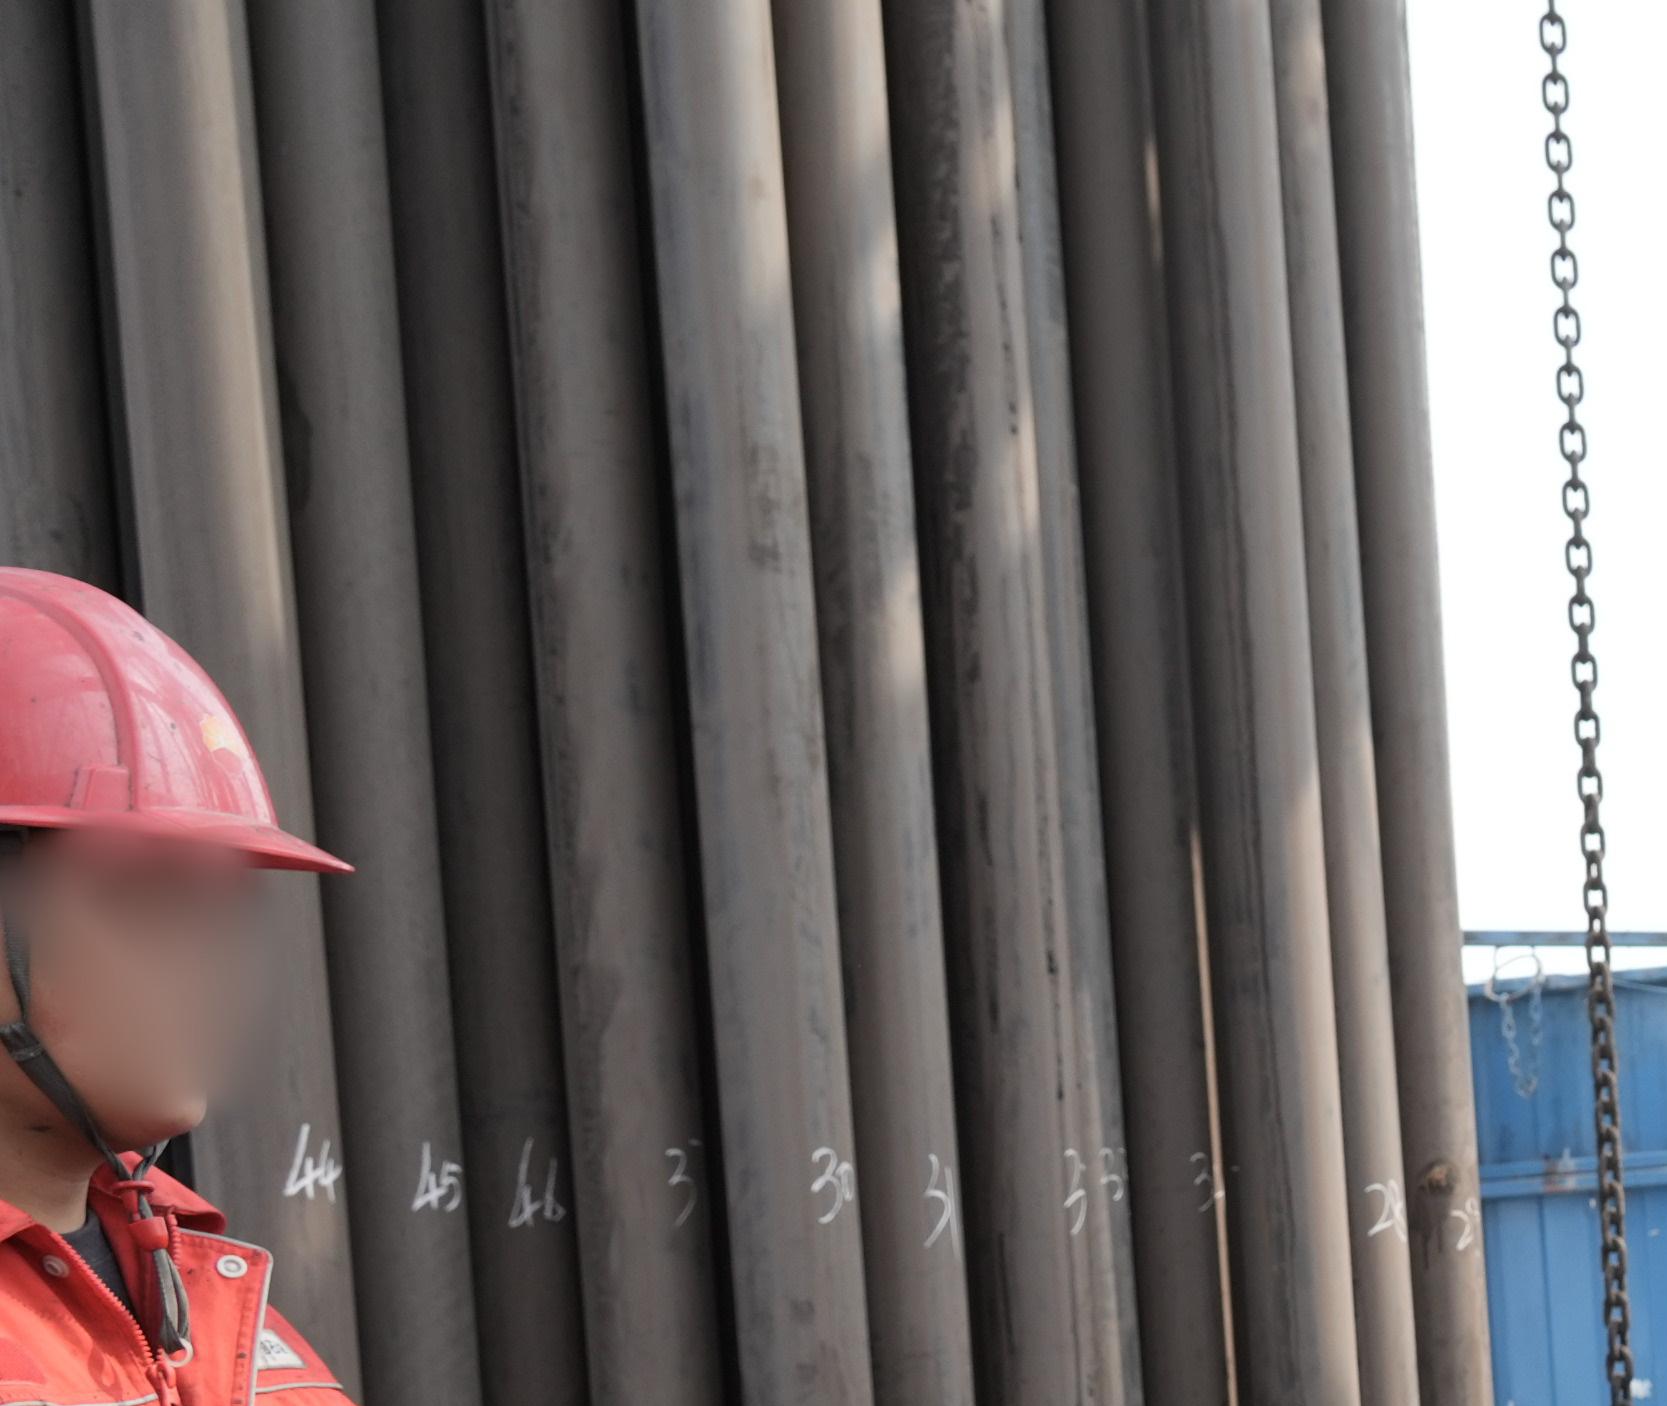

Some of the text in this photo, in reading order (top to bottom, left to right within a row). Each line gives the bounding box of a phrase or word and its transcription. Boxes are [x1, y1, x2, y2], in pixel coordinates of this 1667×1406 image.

[283, 1124, 343, 1203] 44
[411, 1143, 464, 1212] 45
[509, 1137, 566, 1227] 46
